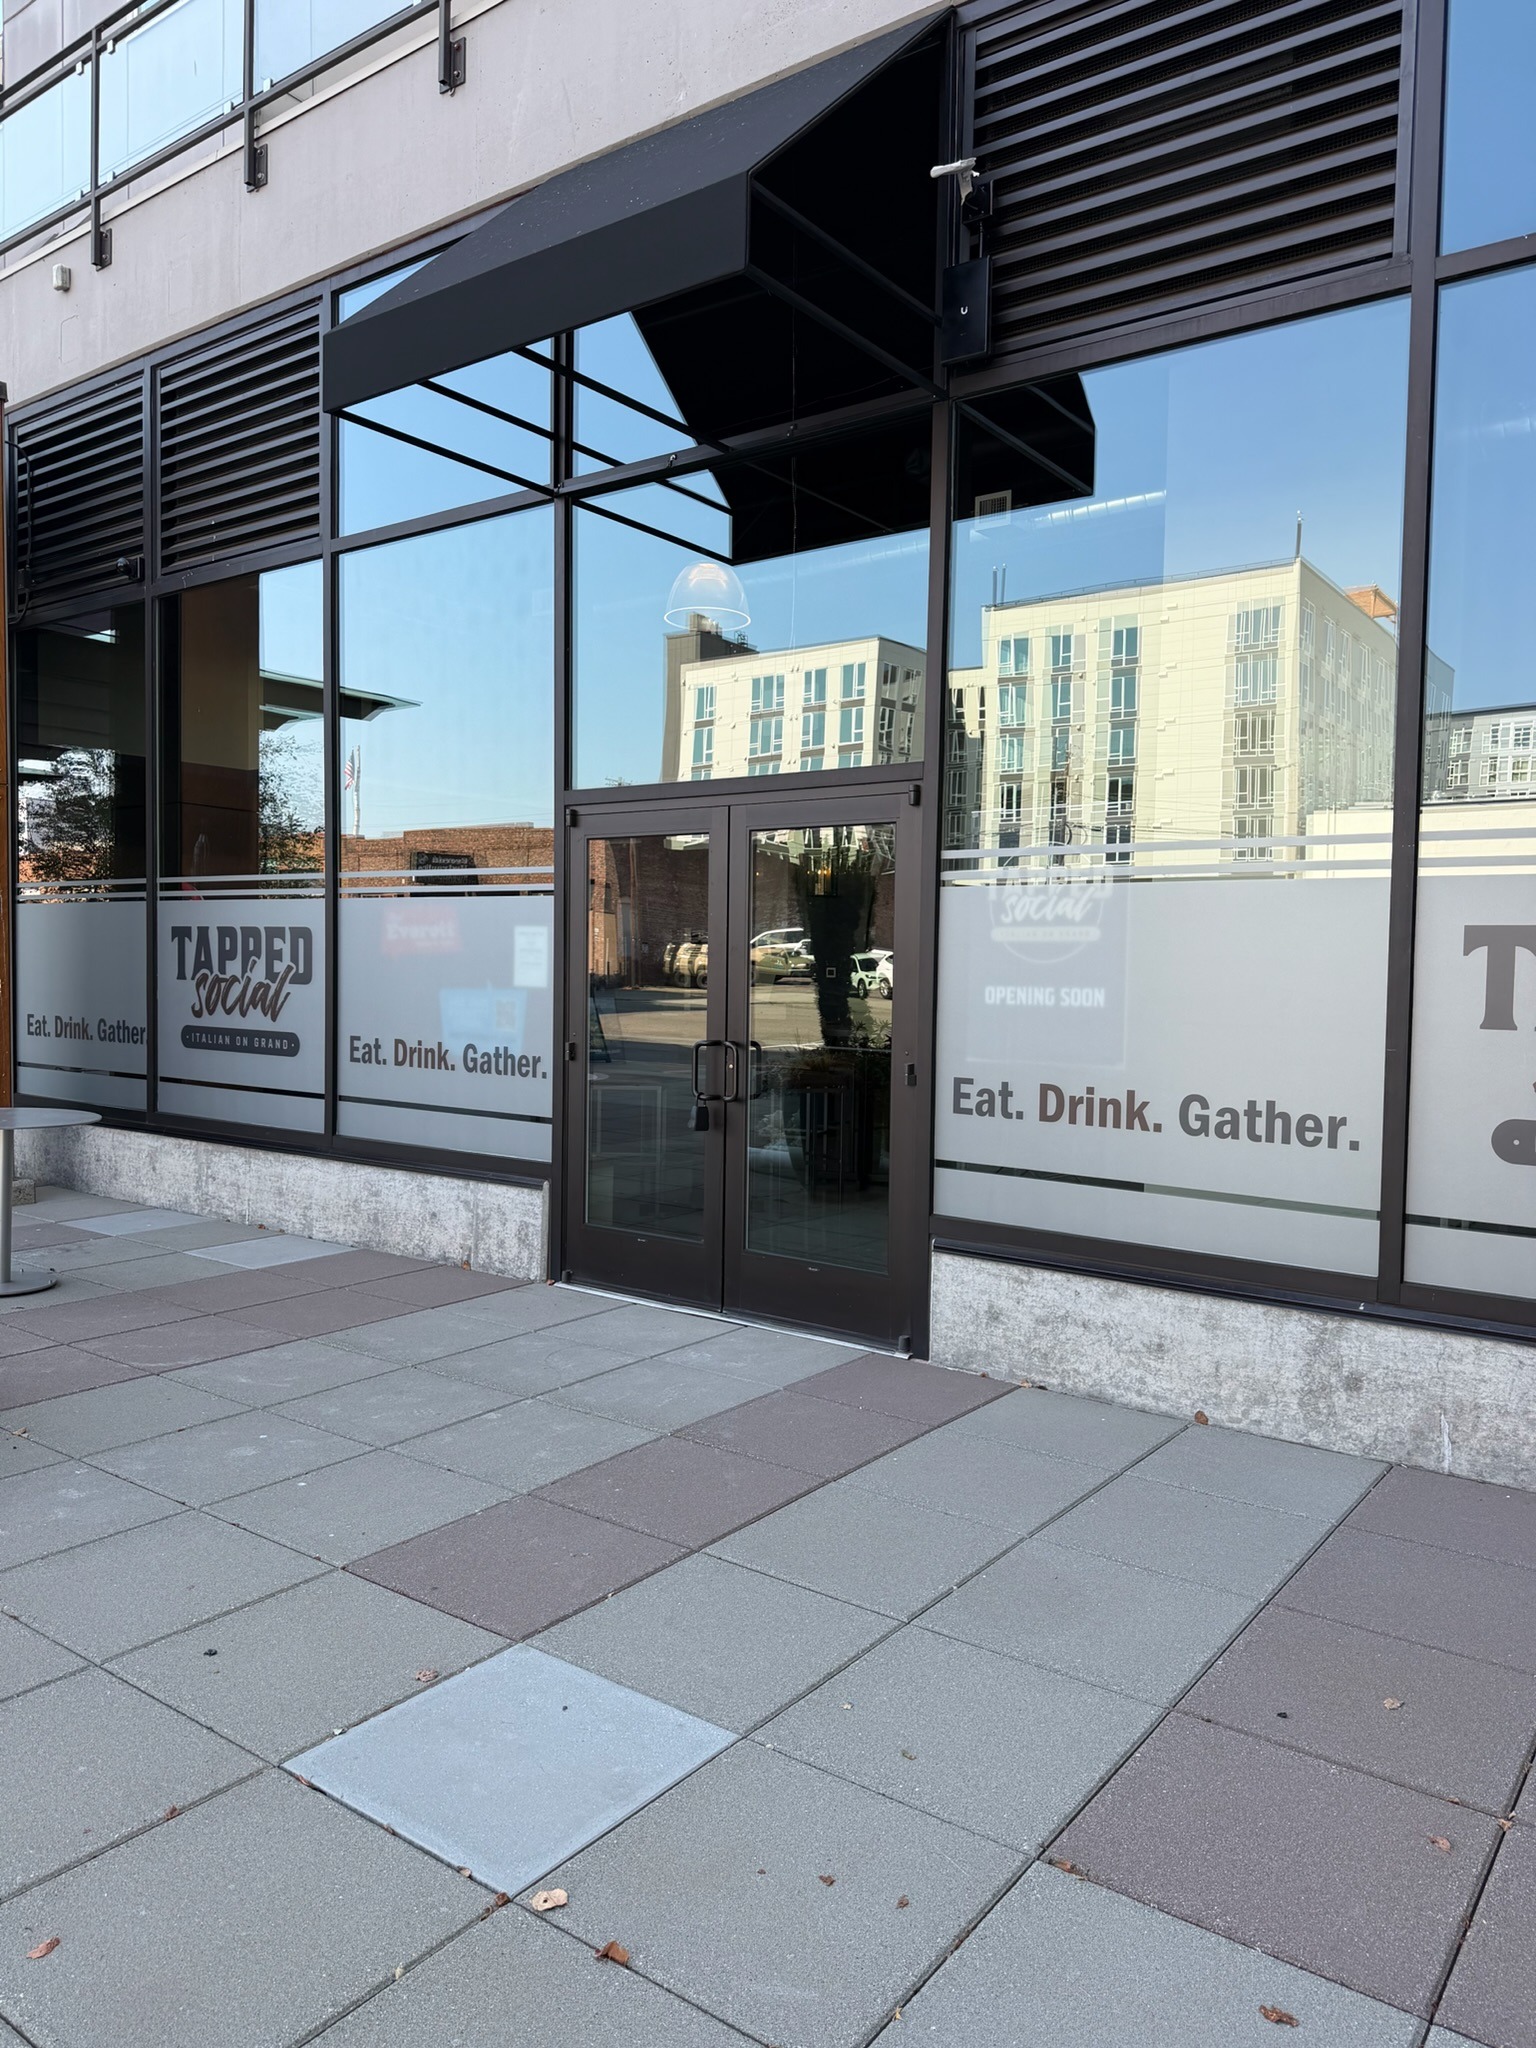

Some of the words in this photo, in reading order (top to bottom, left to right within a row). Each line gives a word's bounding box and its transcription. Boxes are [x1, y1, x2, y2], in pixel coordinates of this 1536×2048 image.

[171, 926, 312, 985] TAPPED
[984, 985, 1055, 1007] OPENING
[1060, 987, 1105, 1008] SOON
[26, 1013, 51, 1037] Eat.
[54, 1015, 93, 1041] Drink.
[97, 1018, 147, 1045] Gather
[191, 1032, 231, 1045] ITALIAN
[235, 1036, 249, 1047] ON
[253, 1037, 289, 1050] GRAND
[349, 1035, 387, 1066] Eat.
[393, 1038, 456, 1072] Drink.
[462, 1043, 548, 1080] Gather.
[952, 1076, 1024, 1121] Eat.
[1038, 1083, 1163, 1133] Drink.
[1178, 1094, 1360, 1152] Gather.
